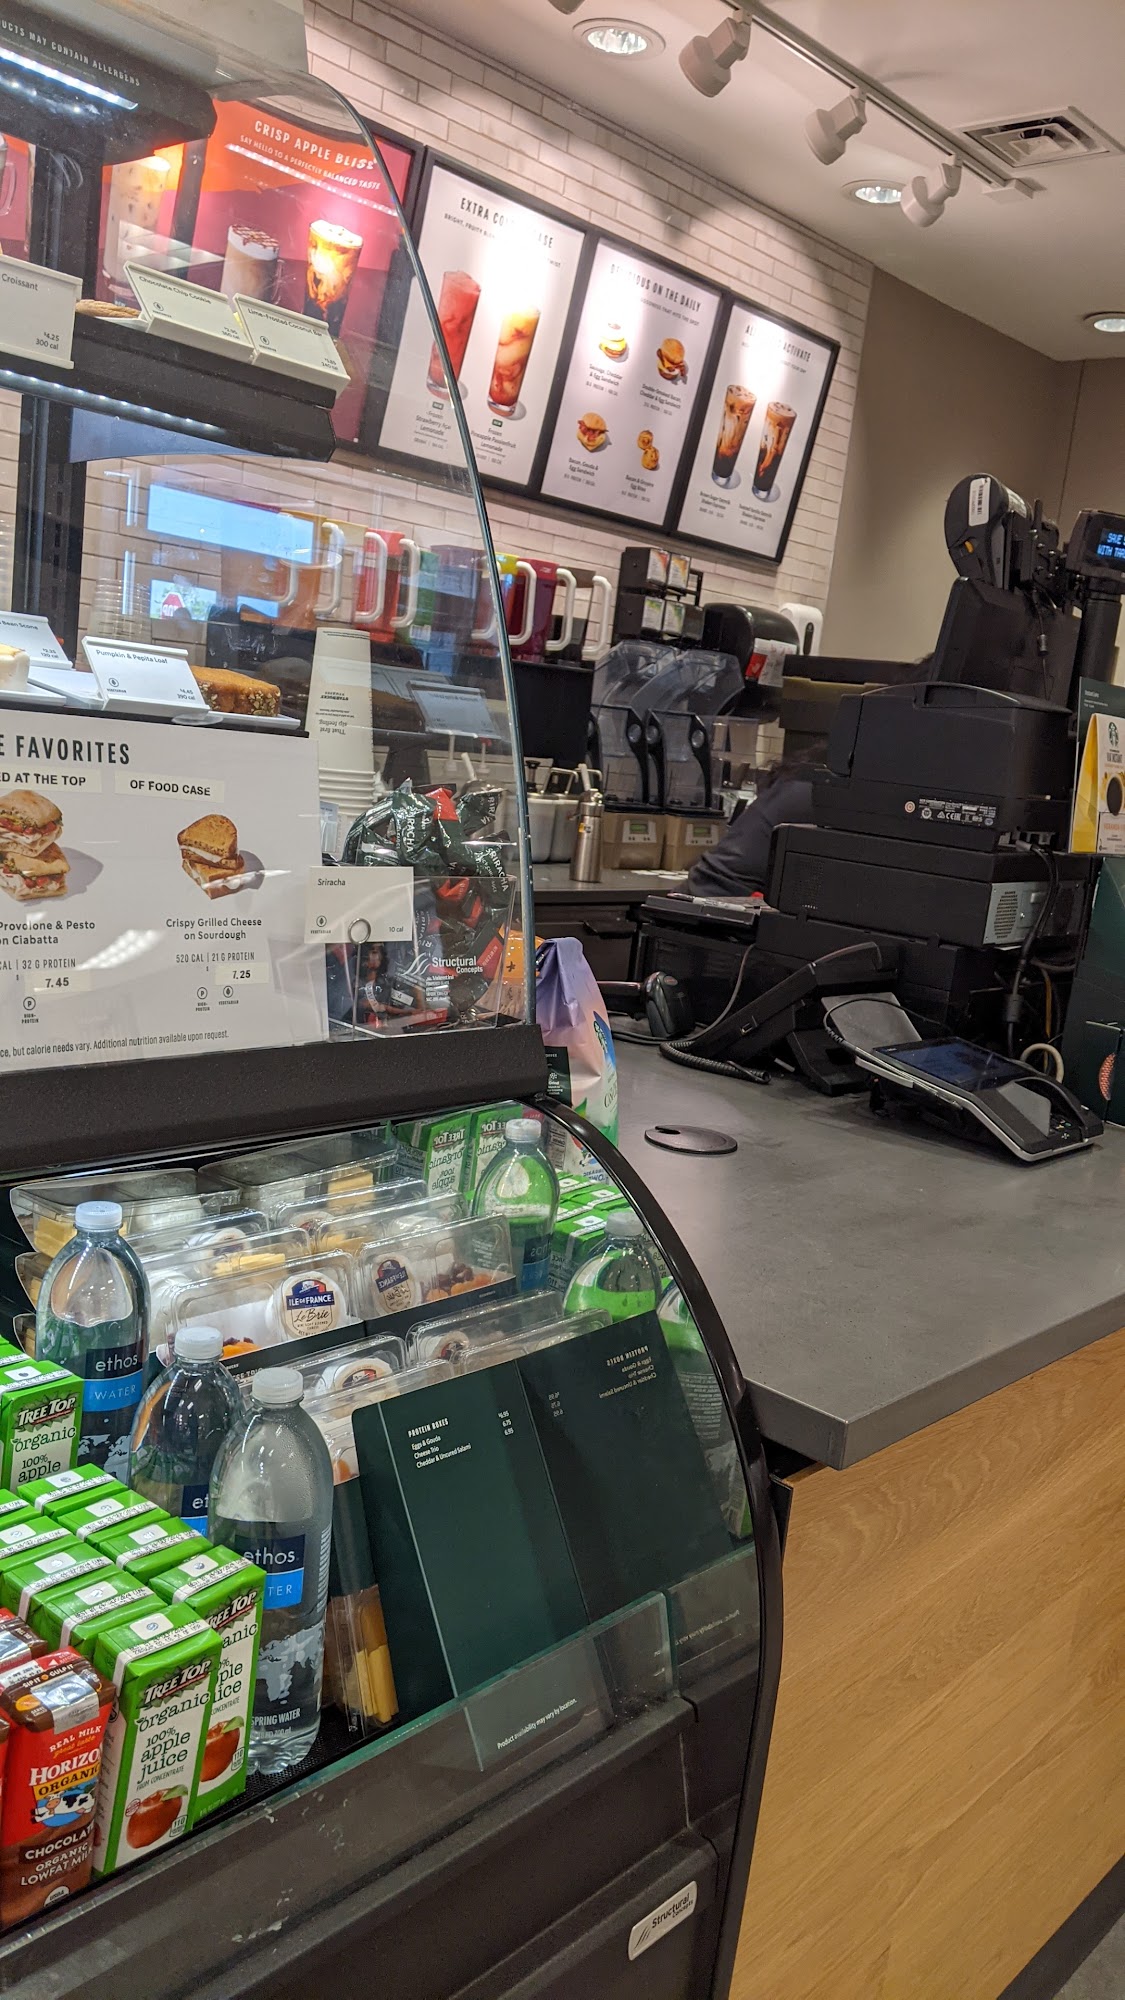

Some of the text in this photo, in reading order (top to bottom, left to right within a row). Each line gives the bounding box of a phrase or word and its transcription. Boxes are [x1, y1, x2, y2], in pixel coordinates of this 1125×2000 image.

[29, 31, 47, 46] MAY
[51, 42, 89, 64] CONTAIN
[92, 60, 140, 86] ALLERGENS
[254, 120, 290, 144] CRISP
[294, 138, 332, 160] APPLE
[240, 134, 253, 146] SAY
[254, 140, 274, 154] HELLO
[274, 149, 283, 159] TO
[290, 156, 323, 175] PERFECTLY
[322, 170, 358, 187] BALANCED
[358, 180, 381, 190] TASTE
[460, 197, 490, 221] EXTRA
[2, 272, 39, 292] Croissant
[652, 282, 702, 313] ON THE DAILY
[36, 338, 59, 350] 300 cal
[44, 331, 60, 342] $4.25
[96, 649, 126, 660] Pumpkin
[132, 654, 154, 664] Pepita
[332, 728, 346, 736] That
[16, 734, 130, 766] FAVORITES
[14, 772, 86, 786] AT THE TOP
[130, 778, 212, 796] OF FOOD CASE
[485, 848, 509, 892] SRIRACHA
[317, 877, 346, 888] Sriracha
[55, 921, 64, 930] &
[66, 920, 96, 930] Pesto
[166, 917, 262, 930] Crispy Grilled Cheese
[12, 934, 59, 945] Ciabatta
[184, 930, 246, 940] on Sourdough
[22, 958, 76, 970] 32 G PROTEIN
[176, 952, 255, 963] 520 CAL 21 G PROTEIN
[432, 955, 477, 968] Structural
[232, 970, 251, 980] 7.25
[456, 966, 484, 974] Concepts
[45, 976, 70, 988] 7.45
[12, 1030, 230, 1058] but calorie needs vary. Additional nutrition available upon request.
[306, 1294, 332, 1304] FRANCE
[294, 1308, 330, 1322] Le Brie
[94, 1352, 138, 1372] ethos
[94, 1384, 136, 1400] WATER
[18, 1396, 74, 1427] TREE TOP
[408, 1417, 449, 1438] PROTEIN BOXES
[14, 1426, 76, 1453] organic
[411, 1441, 422, 1452] Eggs
[426, 1434, 442, 1446] Gouda
[22, 1454, 48, 1470] 100%
[414, 1446, 440, 1460] Cheese Trio
[416, 1456, 436, 1469] Cheddar
[440, 1448, 458, 1460] Uncured
[456, 1442, 472, 1454] Salami
[18, 1460, 62, 1484] apple
[244, 1546, 296, 1566] ethos
[268, 1584, 292, 1597] TER
[22, 1680, 34, 1688] SIP
[34, 1676, 40, 1684] IT
[50, 1666, 67, 1677] GULP
[144, 1660, 209, 1704] TREE TOP
[138, 1692, 210, 1733] organic
[252, 1708, 300, 1726] SPRING WATER
[50, 1724, 102, 1753] REAL MILK
[140, 1731, 190, 1763] apple
[146, 1726, 176, 1748] 100%
[496, 1735, 515, 1750] Product
[138, 1748, 188, 1784] juice
[38, 1764, 100, 1798] ORGANIC
[136, 1765, 184, 1792] FROM CONCENTRATE
[174, 1816, 186, 1828] 110
[35, 1842, 88, 1872] ORGANIC
[20, 1860, 70, 1887] LOWFAT
[652, 1892, 690, 1929] Structural
